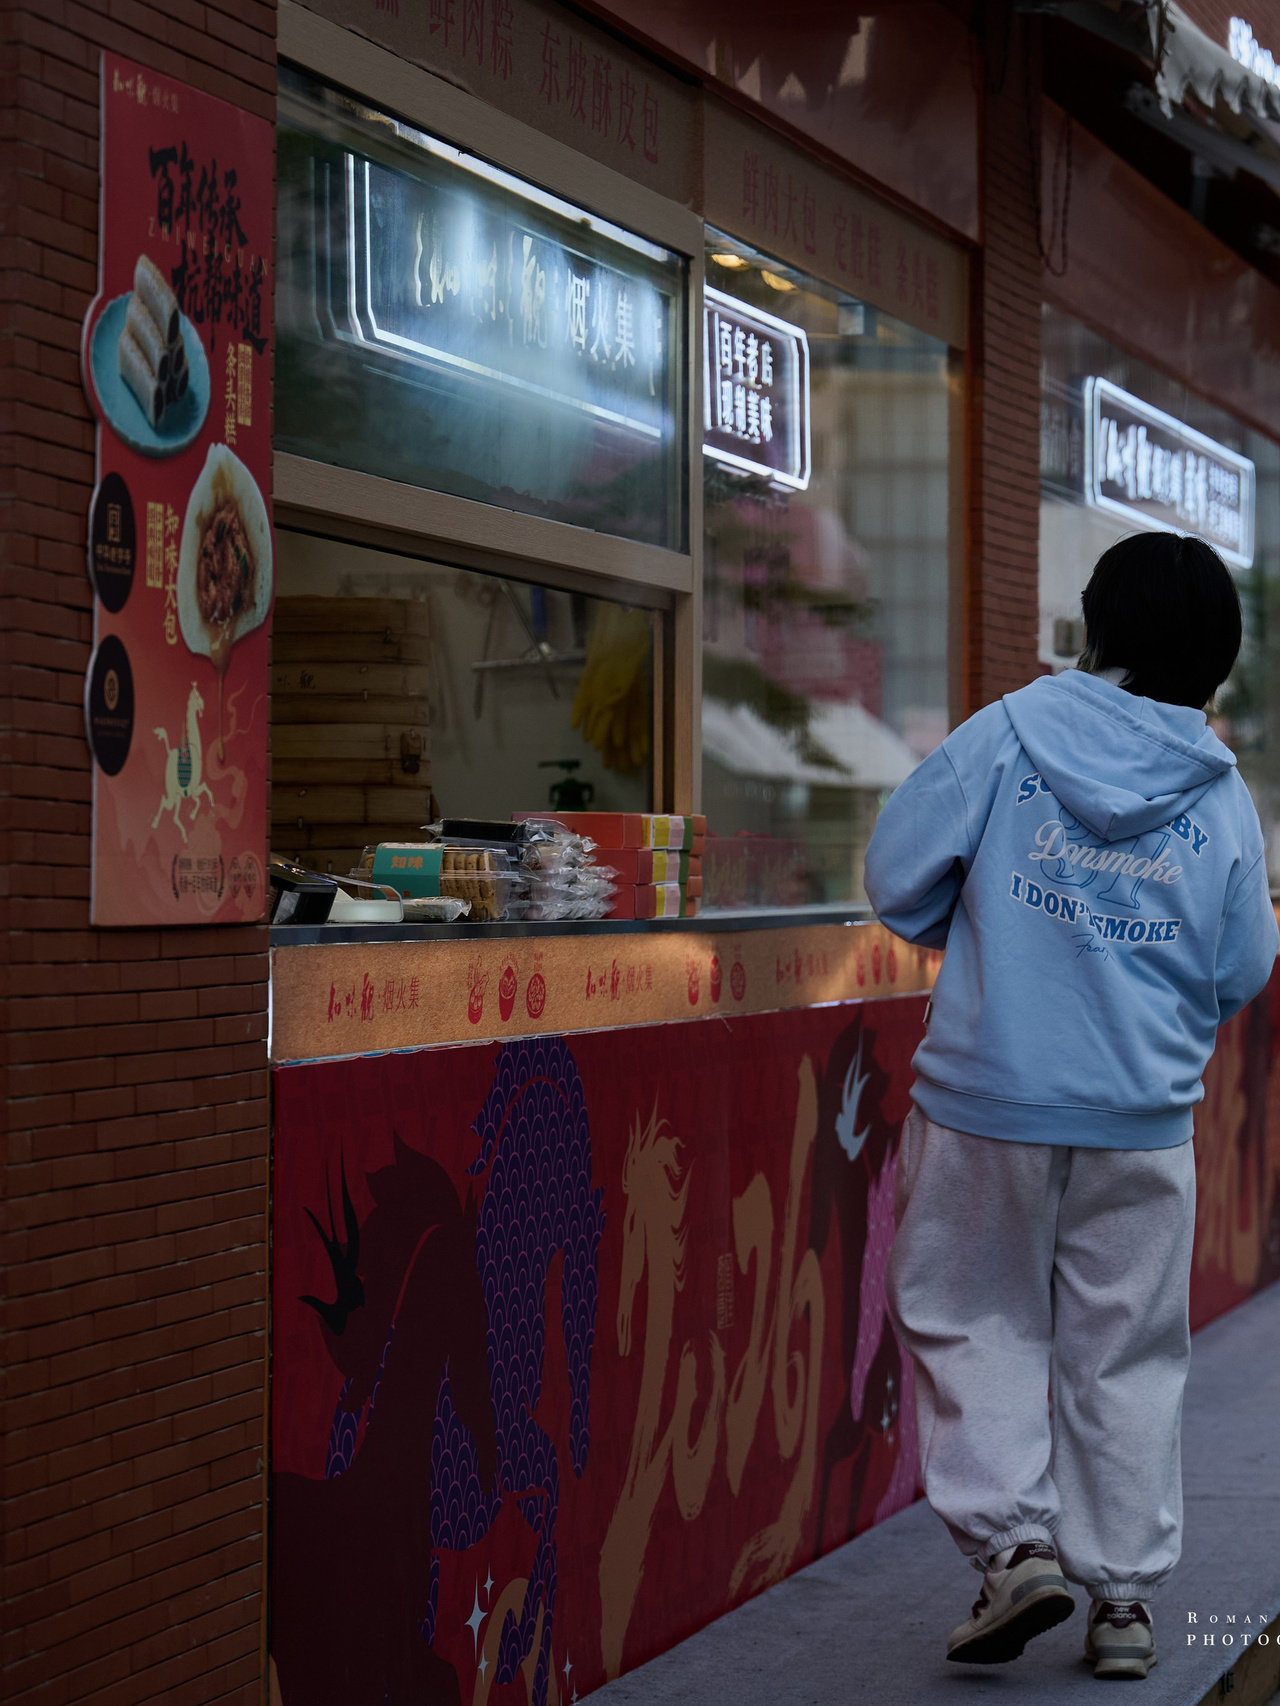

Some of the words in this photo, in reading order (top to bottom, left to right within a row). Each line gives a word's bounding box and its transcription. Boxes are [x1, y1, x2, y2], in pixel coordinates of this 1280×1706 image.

[539, 19, 659, 165] 东坡酥皮包
[148, 141, 247, 246] 百年传承
[171, 229, 268, 356] 杭帮味道
[163, 503, 180, 646] 知味大包
[390, 855, 424, 870] 知味
[1010, 871, 1025, 901] I
[1091, 912, 1182, 945] SMOKE
[1106, 1611, 1138, 1620] balance
